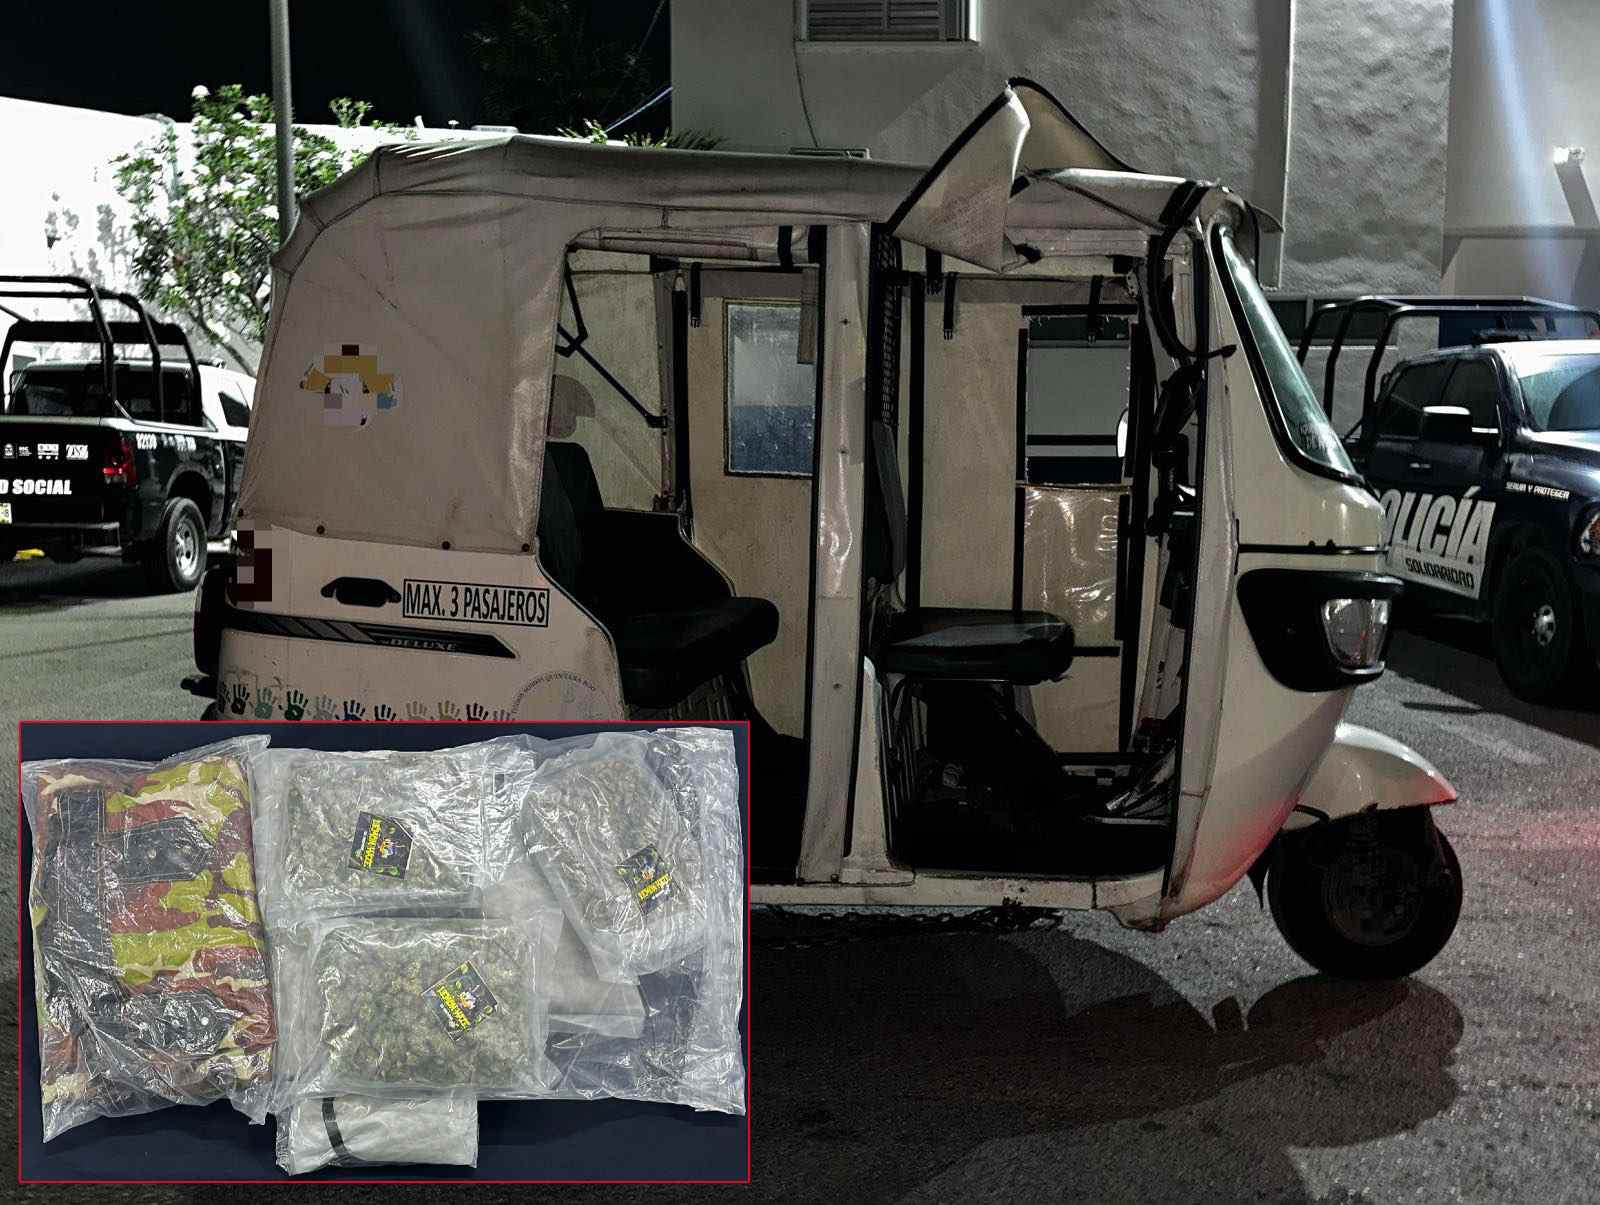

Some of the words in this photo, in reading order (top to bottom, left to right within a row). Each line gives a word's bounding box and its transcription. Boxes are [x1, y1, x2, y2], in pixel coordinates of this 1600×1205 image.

[12, 479, 73, 495] SOCIAL
[1534, 485, 1570, 499] PROTEGER
[1373, 485, 1497, 568] OLICÍA
[406, 582, 445, 617] MAX.
[449, 585, 459, 617] 3
[463, 586, 546, 623] PASAJEROS
[390, 638, 458, 651] DELUXE
